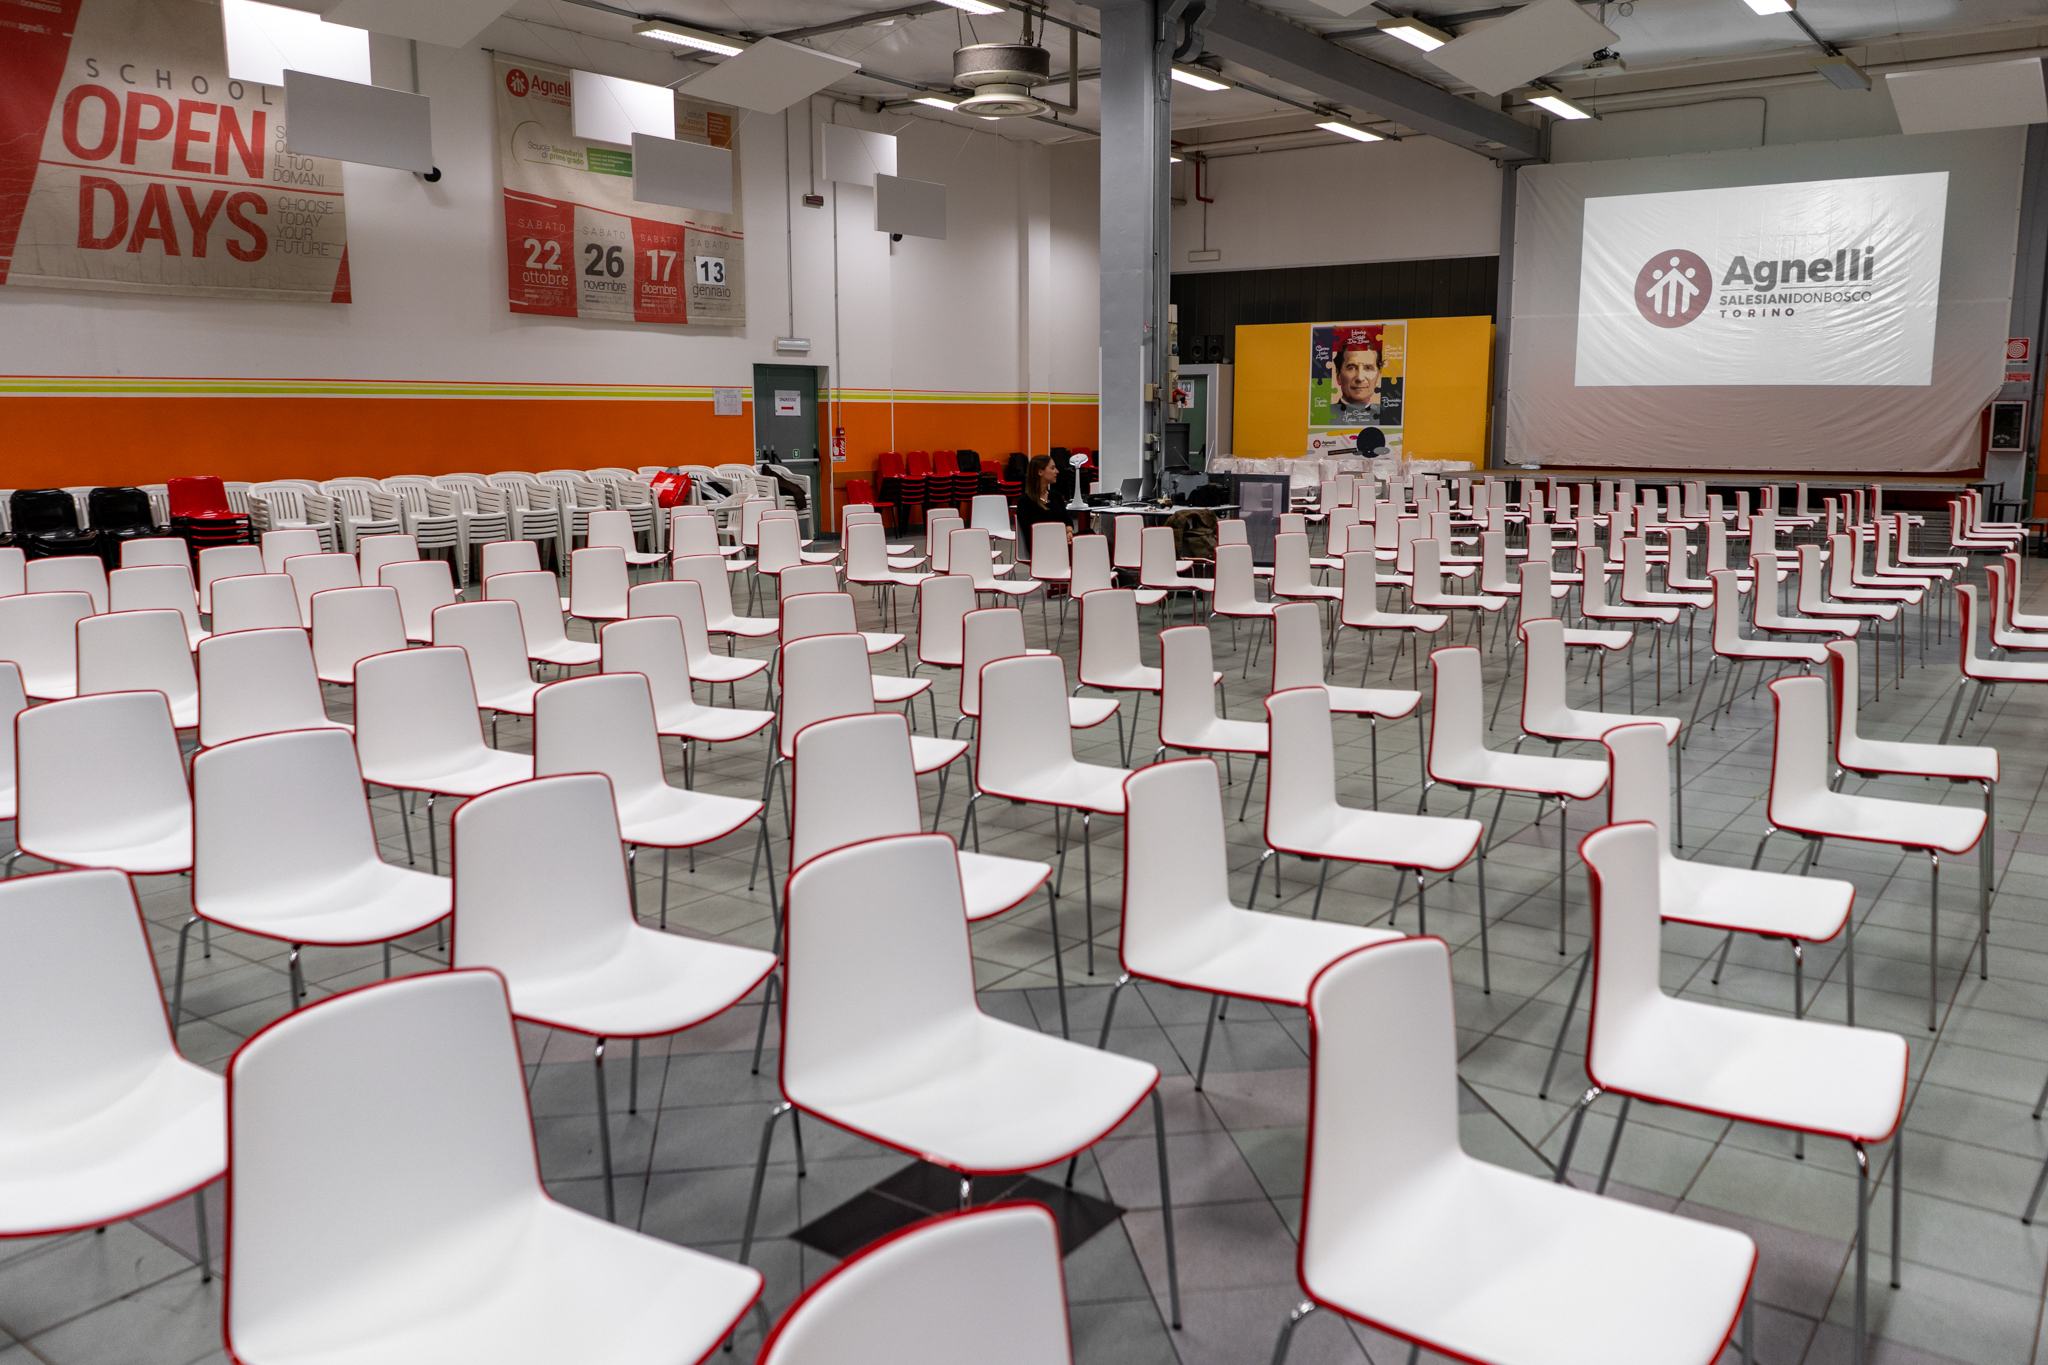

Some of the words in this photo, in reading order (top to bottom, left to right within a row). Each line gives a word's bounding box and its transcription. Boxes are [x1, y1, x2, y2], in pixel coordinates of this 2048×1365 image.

[85, 58, 273, 106] SCHOOL
[531, 74, 571, 97] Agnell
[62, 83, 267, 180] OPEN
[527, 141, 551, 152] Scuola
[551, 145, 584, 158] Secondaria
[274, 154, 285, 168] IL
[287, 155, 314, 171] TUO
[549, 153, 567, 162] primo
[566, 157, 585, 165] grado
[272, 168, 325, 187] DOMANI
[277, 196, 334, 215] CHOOSE
[76, 174, 269, 263] DAYS
[277, 210, 323, 228] TODAY
[518, 218, 567, 233] SABATO
[276, 225, 314, 241] YOUR
[582, 226, 626, 240] SABATO
[640, 233, 678, 245] SABATO
[275, 239, 330, 257] FUTURE
[690, 238, 730, 251] SABATO
[523, 238, 563, 271] 22
[584, 243, 625, 279] 26
[646, 248, 677, 282] 17
[700, 260, 724, 283] 13
[1721, 245, 1875, 292] Agnelli
[522, 270, 569, 286] ottobre
[583, 279, 627, 292] novembre
[641, 282, 678, 295] dicembre
[692, 284, 732, 299] gennaio
[1719, 307, 1796, 319] TORINO
